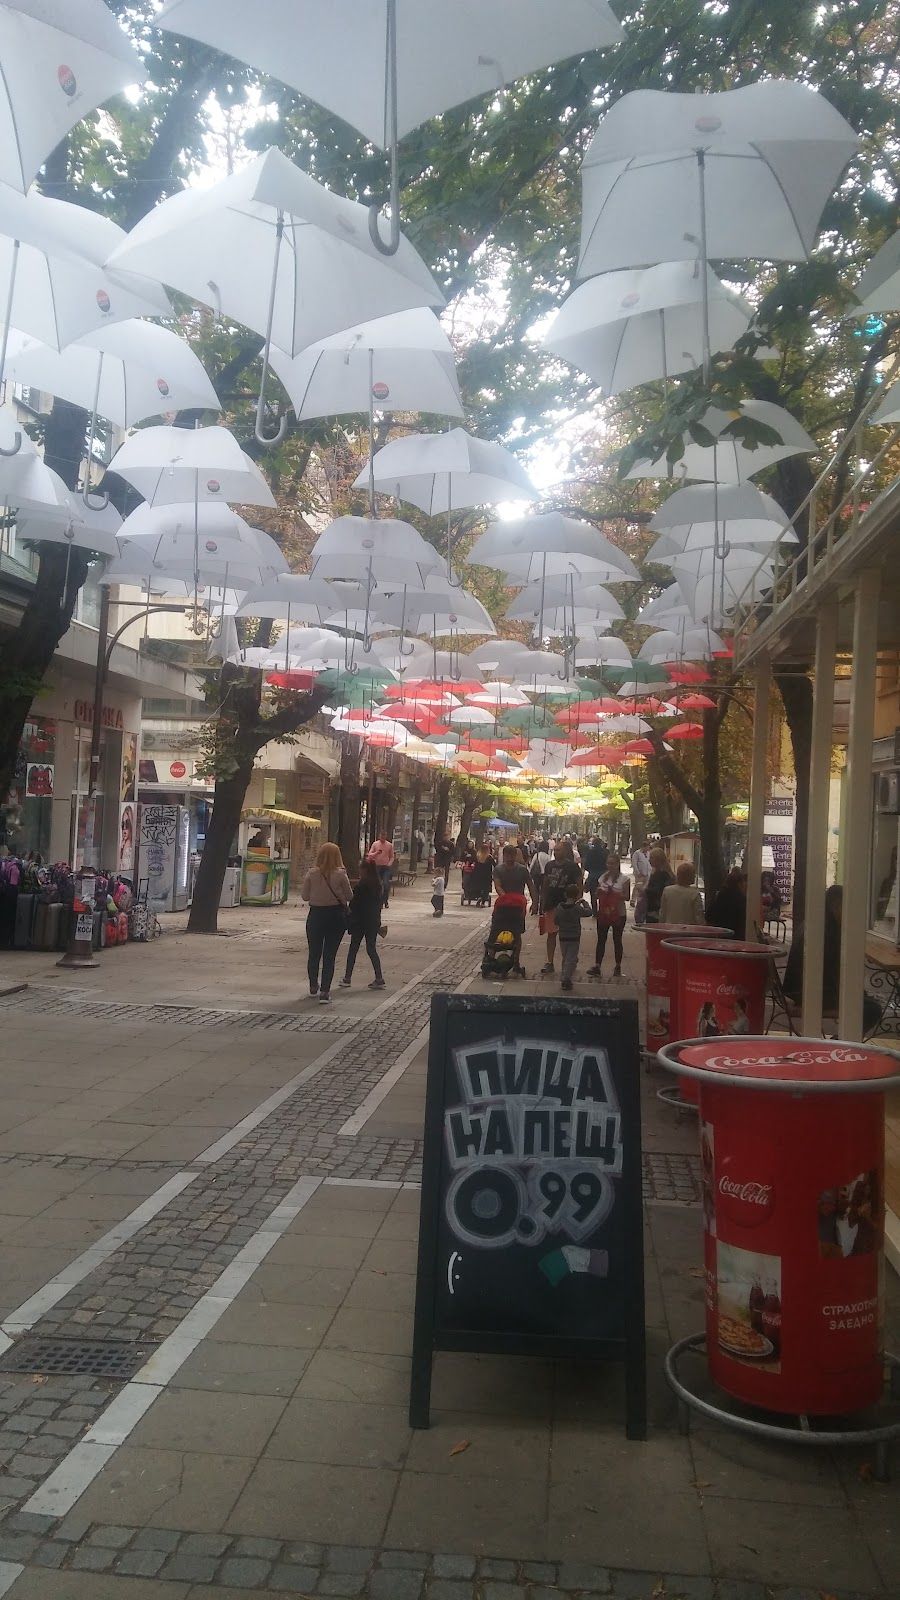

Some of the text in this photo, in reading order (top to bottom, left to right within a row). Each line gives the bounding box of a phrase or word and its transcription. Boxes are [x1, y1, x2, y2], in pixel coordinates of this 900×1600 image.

[459, 1044, 613, 1106] ПИЦА
[705, 1048, 868, 1070] Coca-Cola
[447, 1106, 620, 1168] НА ПЕЩ
[449, 1165, 608, 1240] 0.99
[718, 1175, 772, 1205] Coca-Cola
